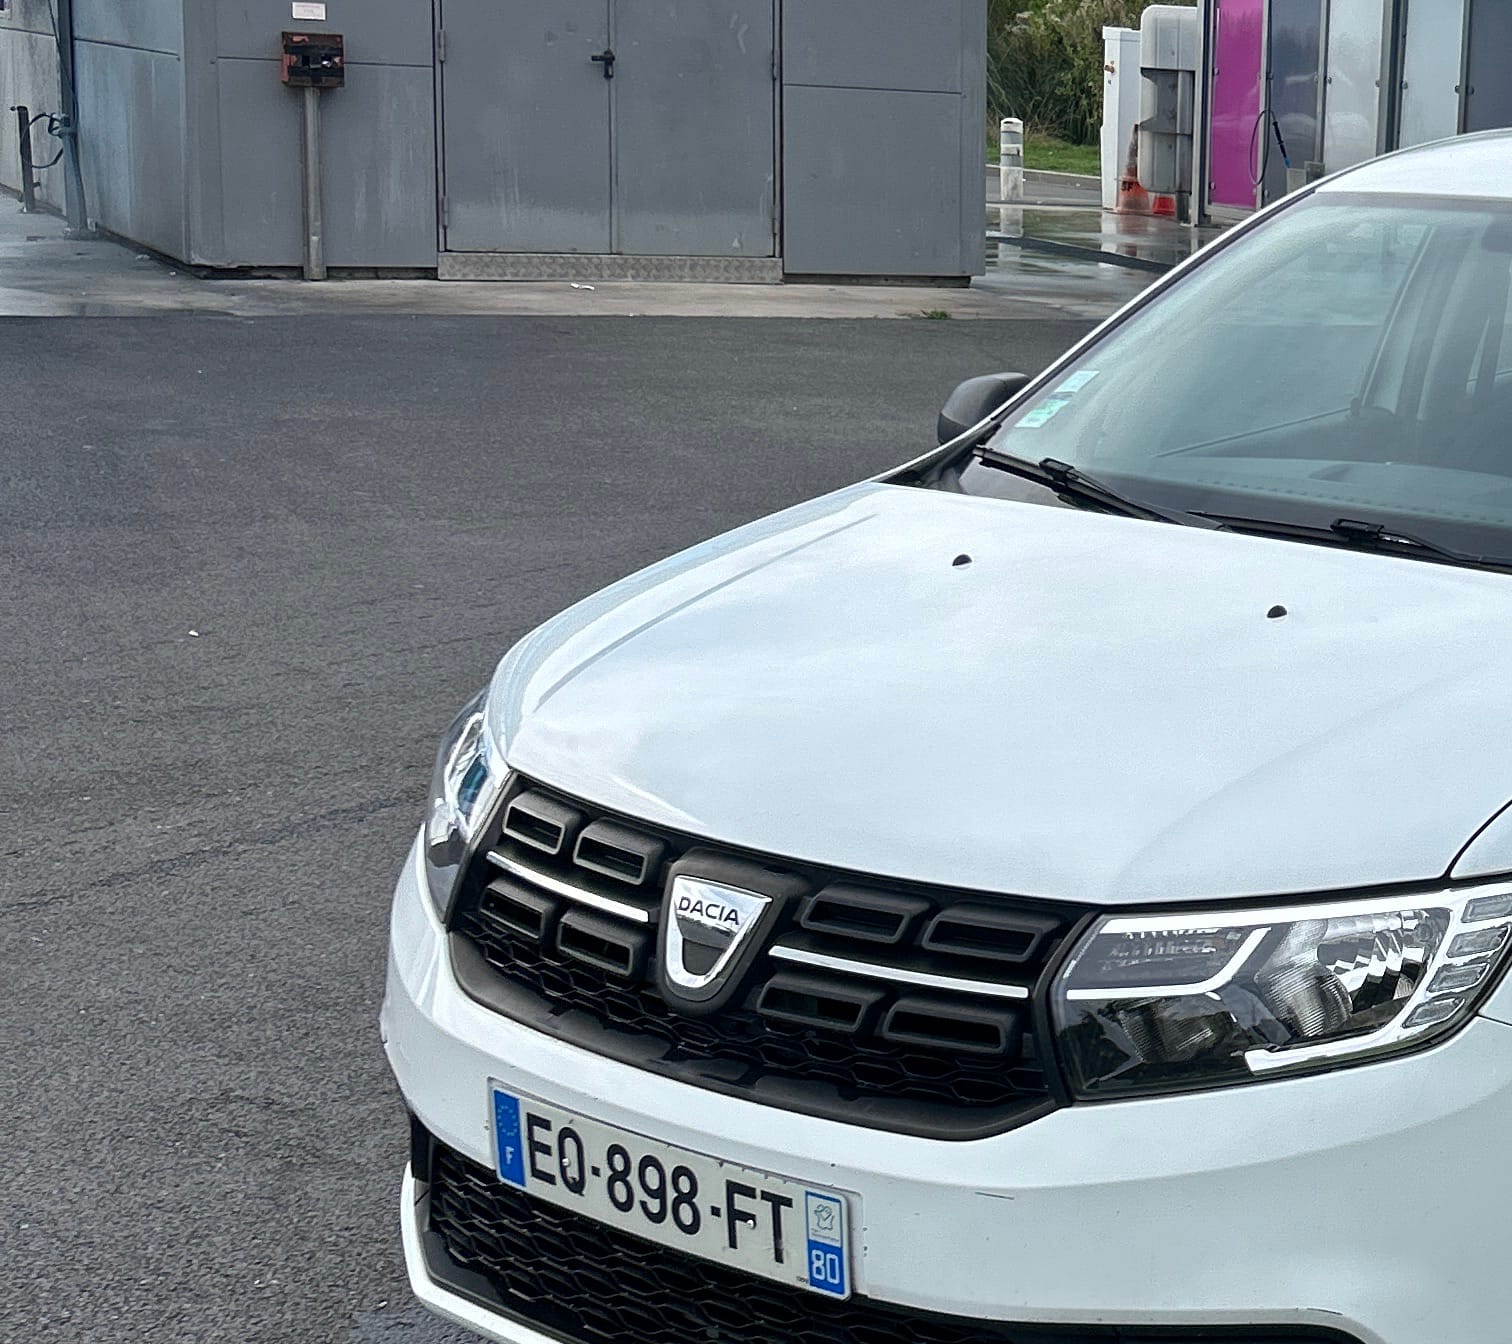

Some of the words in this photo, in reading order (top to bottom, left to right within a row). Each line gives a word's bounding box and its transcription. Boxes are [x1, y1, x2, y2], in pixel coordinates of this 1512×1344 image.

[678, 895, 740, 925] DACIA
[506, 1146, 515, 1164] F
[526, 1112, 793, 1264] EQ-898-FT
[811, 1249, 841, 1284] 80
